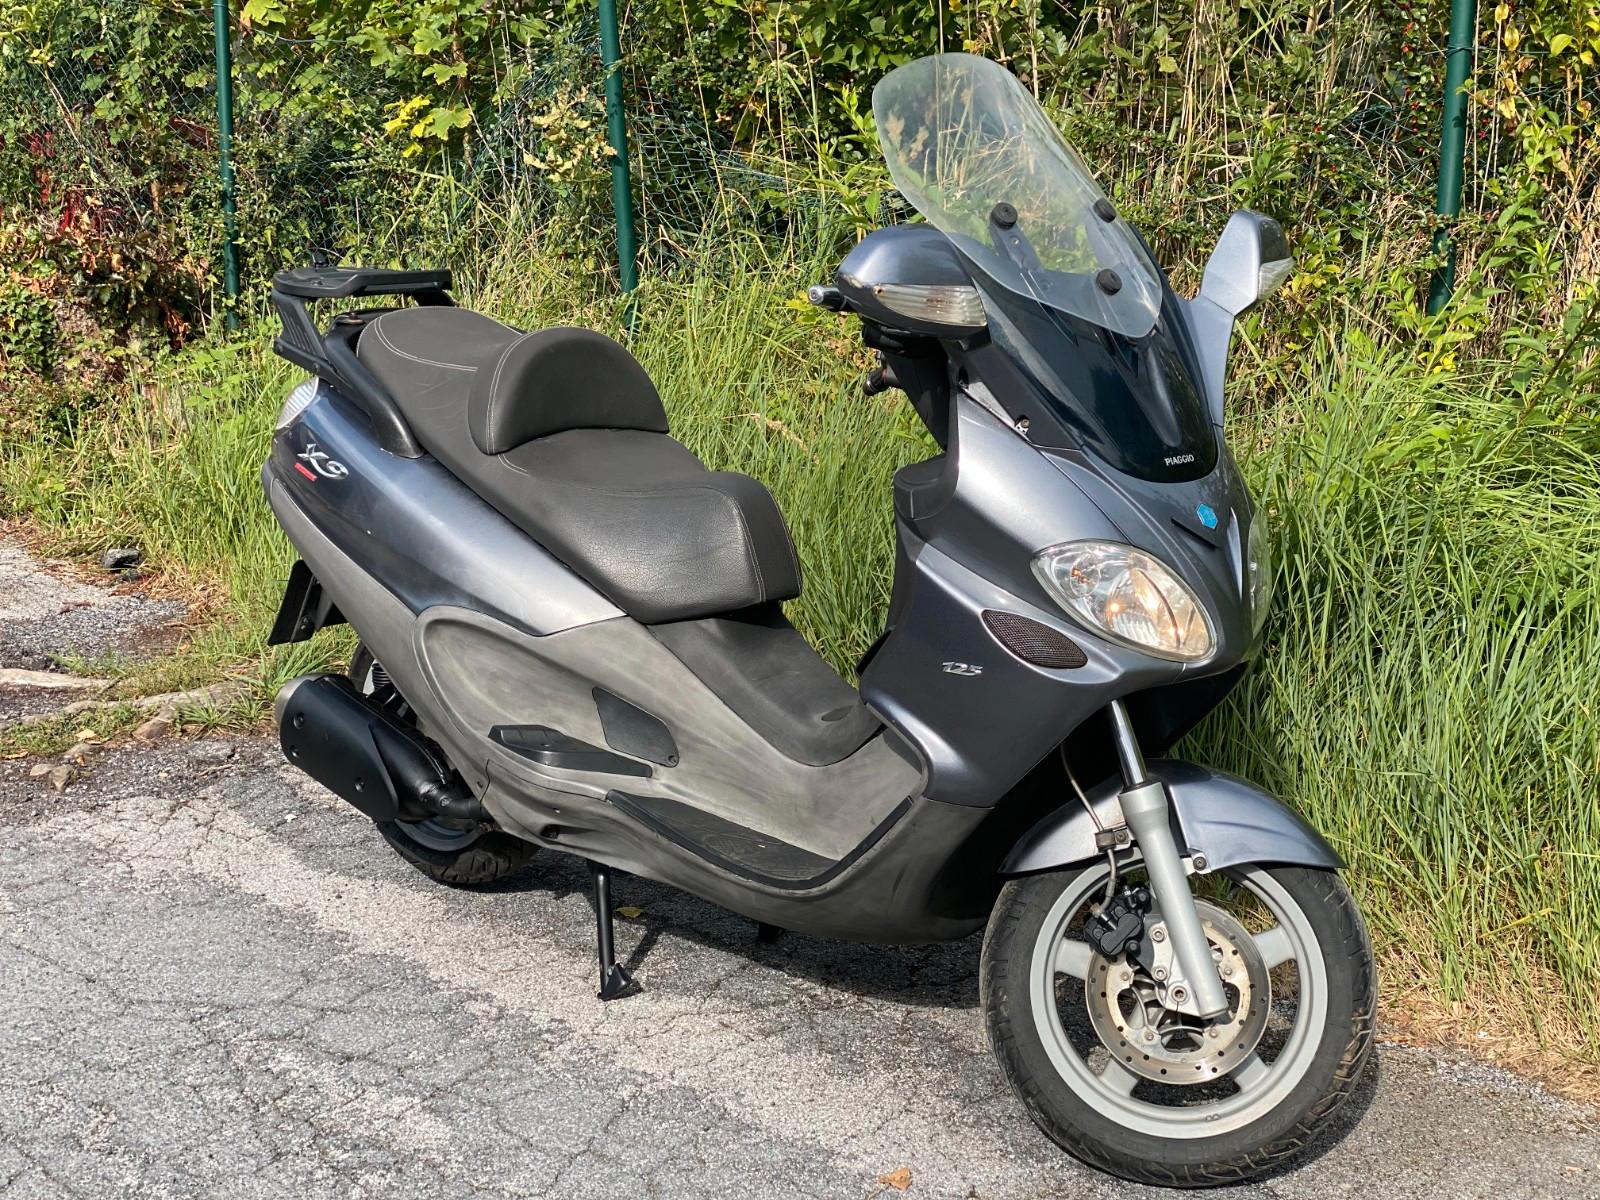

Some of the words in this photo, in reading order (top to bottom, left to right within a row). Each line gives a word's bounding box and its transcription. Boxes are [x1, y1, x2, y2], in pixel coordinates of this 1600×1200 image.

[297, 443, 349, 479] X9
[1164, 454, 1195, 466] PIAGGIO
[942, 661, 983, 676] 125
